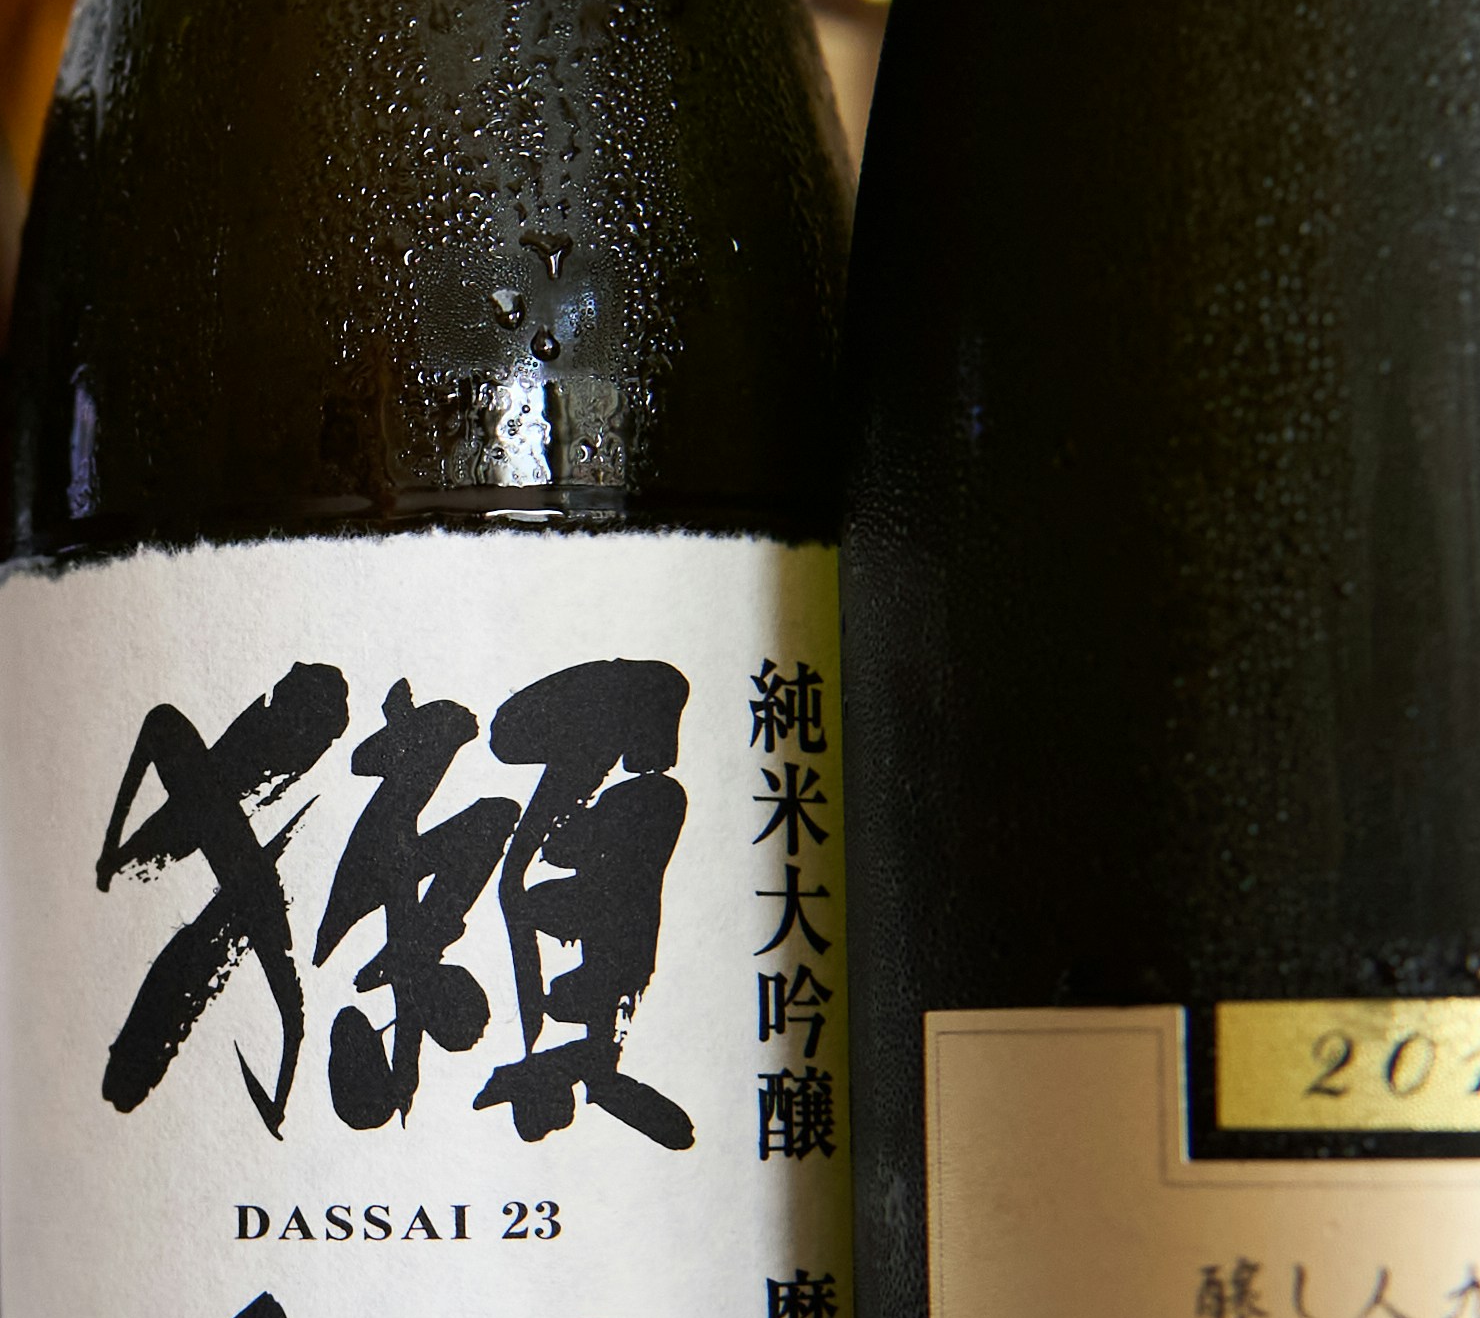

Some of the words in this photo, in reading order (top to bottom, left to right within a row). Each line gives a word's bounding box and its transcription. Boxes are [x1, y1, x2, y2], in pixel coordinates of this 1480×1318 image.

[748, 657, 838, 1163] 純米大吟醸
[234, 1204, 473, 1242] DASSAI
[500, 1200, 562, 1241] 23
